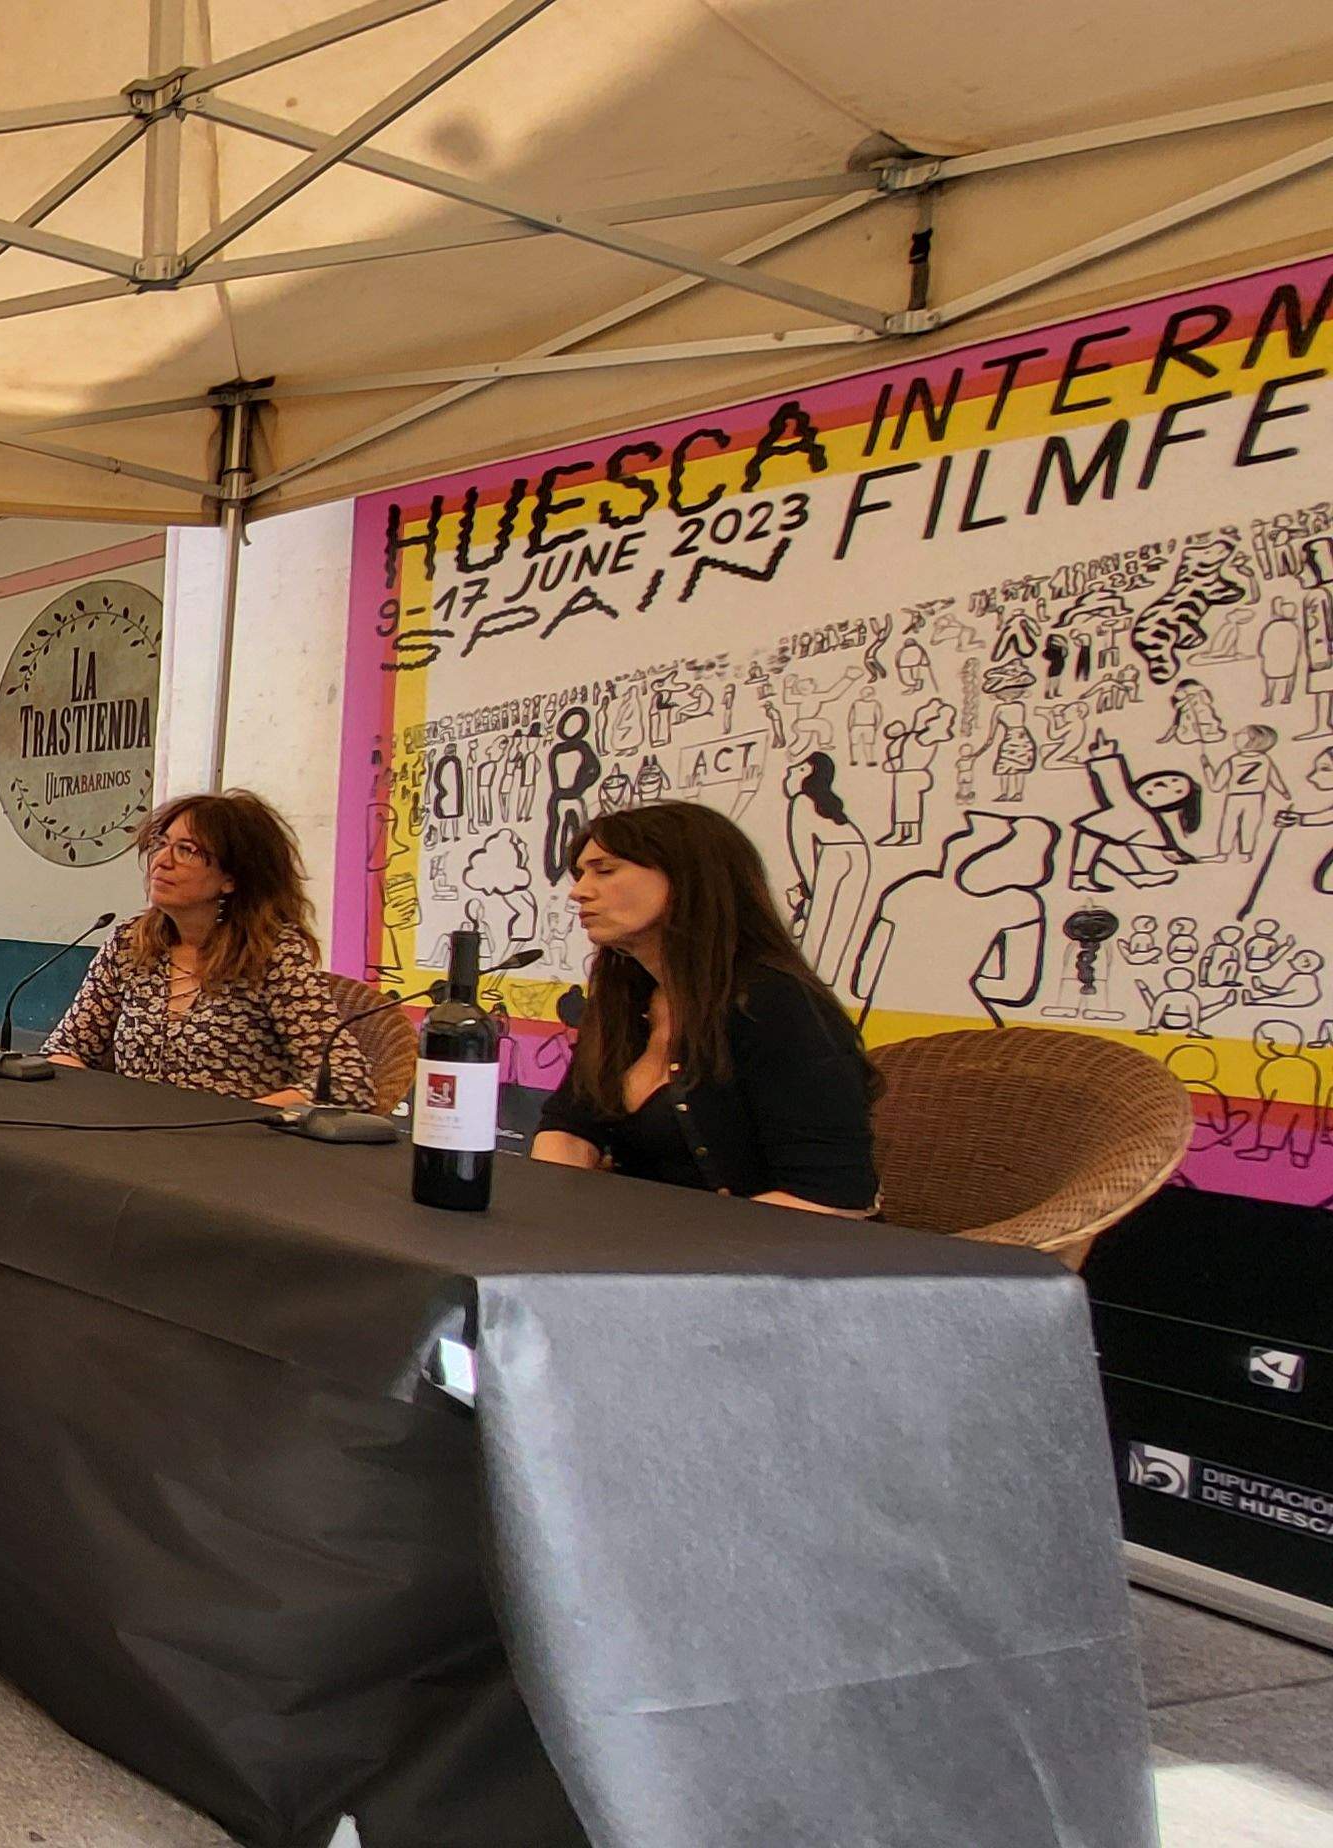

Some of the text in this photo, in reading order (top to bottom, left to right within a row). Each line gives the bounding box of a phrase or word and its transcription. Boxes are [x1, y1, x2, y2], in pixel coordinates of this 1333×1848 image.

[385, 402, 829, 589] HUESCA
[376, 492, 810, 637] 9-17 JUNE 2023
[380, 536, 792, 672] SPAIN
[71, 647, 97, 702] LA
[20, 697, 151, 758] TRASTIENDA
[45, 769, 131, 805] ULTRABARINOS
[692, 741, 757, 778] ACT
[1201, 1485, 1234, 1506] DE
